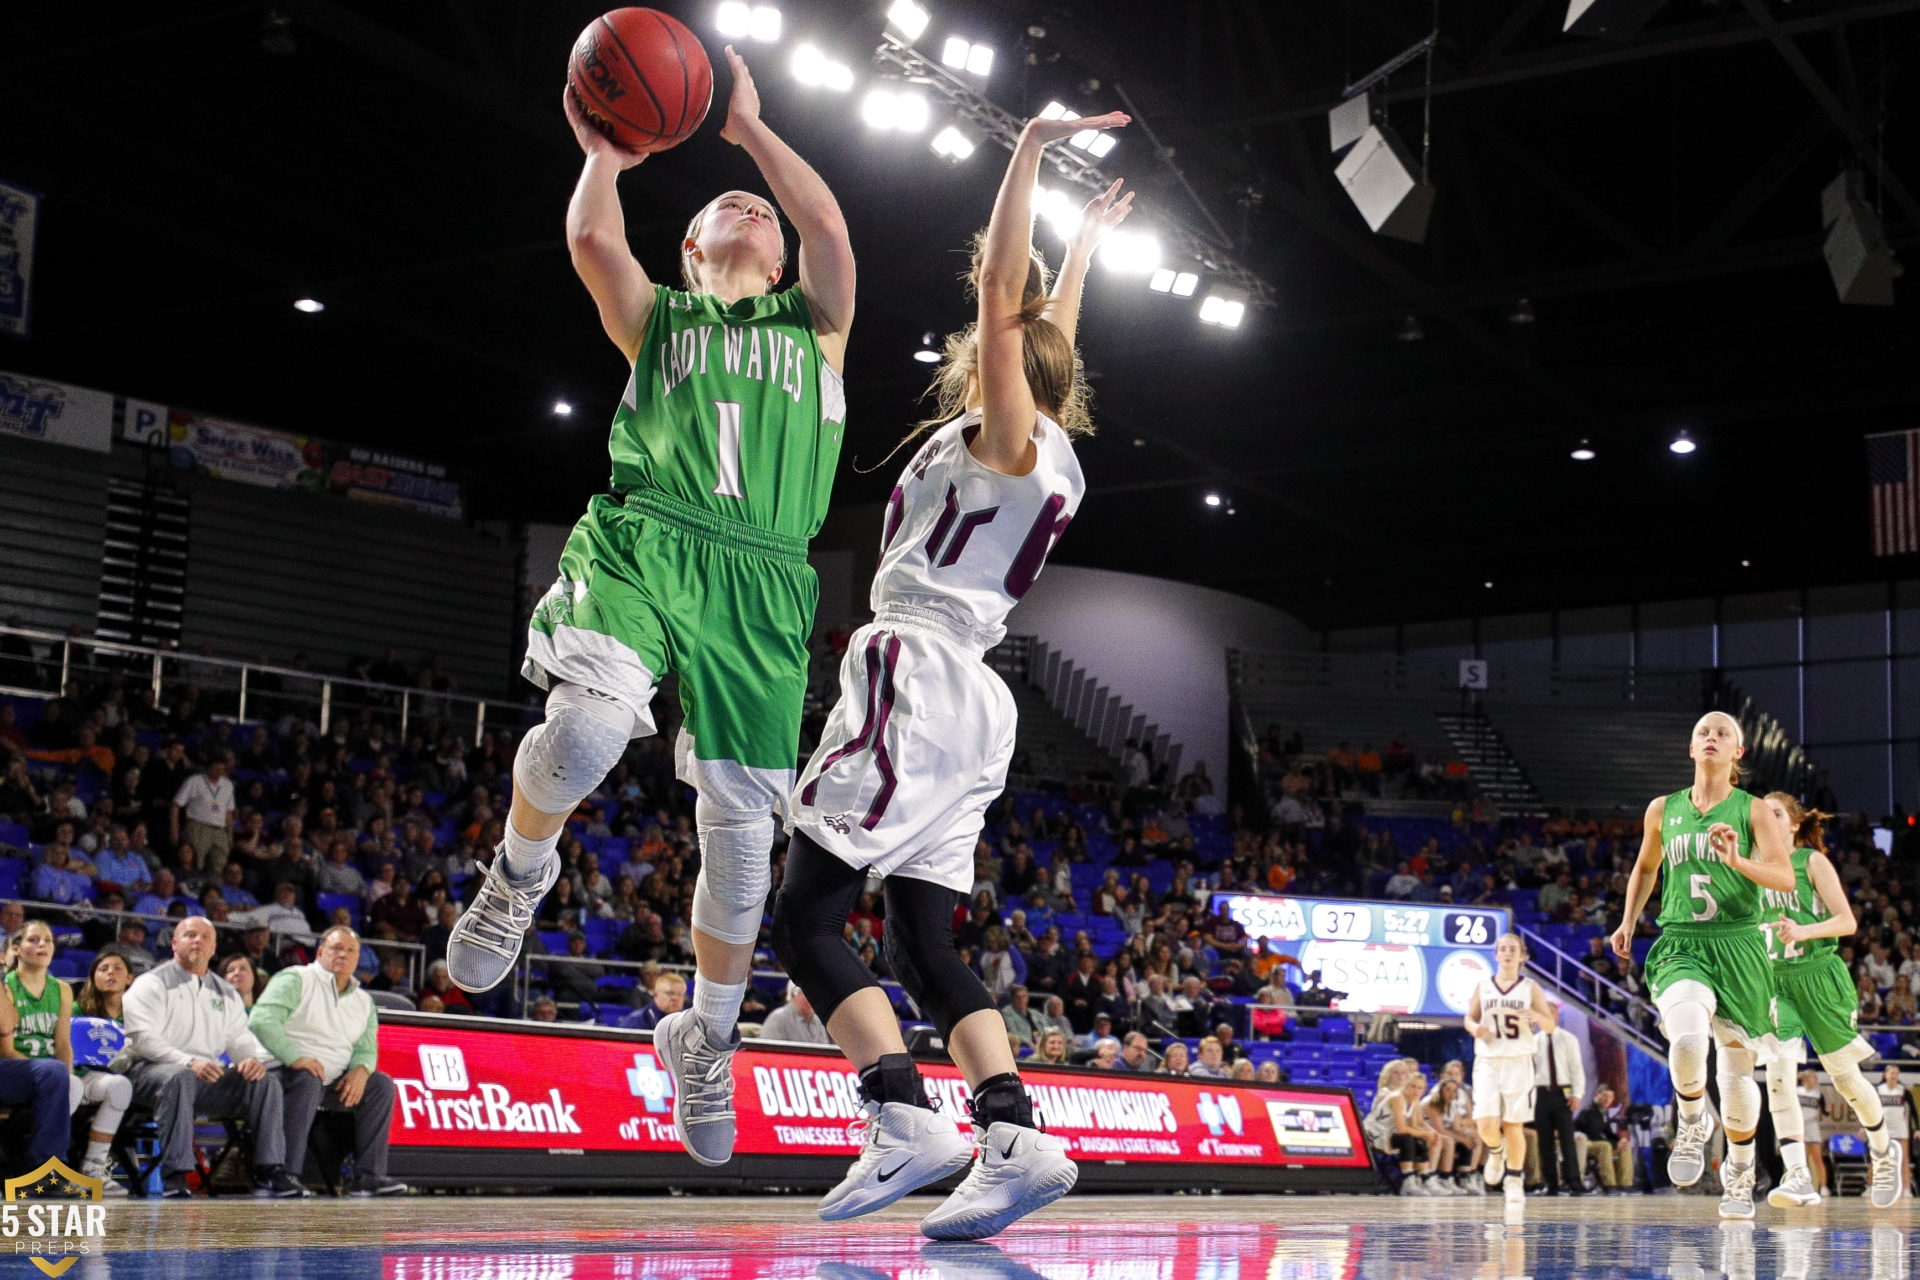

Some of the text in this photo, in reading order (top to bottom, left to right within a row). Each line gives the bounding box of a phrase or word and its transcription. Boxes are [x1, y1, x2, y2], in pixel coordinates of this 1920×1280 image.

[661, 323, 804, 403] LADY WAVES
[136, 409, 156, 432] P
[711, 400, 744, 499] 1
[1467, 665, 1480, 683] S
[1665, 833, 1691, 871] LADY
[1690, 873, 1718, 921] 5
[1326, 911, 1356, 934] 37
[1383, 909, 1430, 932] 5:27
[1455, 915, 1488, 944] 26
[1493, 1013, 1520, 1040] 15
[426, 1052, 462, 1084] FB
[392, 1078, 583, 1134] FirstBank
[1022, 1083, 1177, 1134] CHAMPIONSHIPS
[619, 1116, 640, 1141] of
[773, 1125, 847, 1146] TENNESSEE
[1079, 1136, 1119, 1153] DIVISION
[1123, 1138, 1150, 1155] STATE
[1149, 1139, 1181, 1157] FINALS
